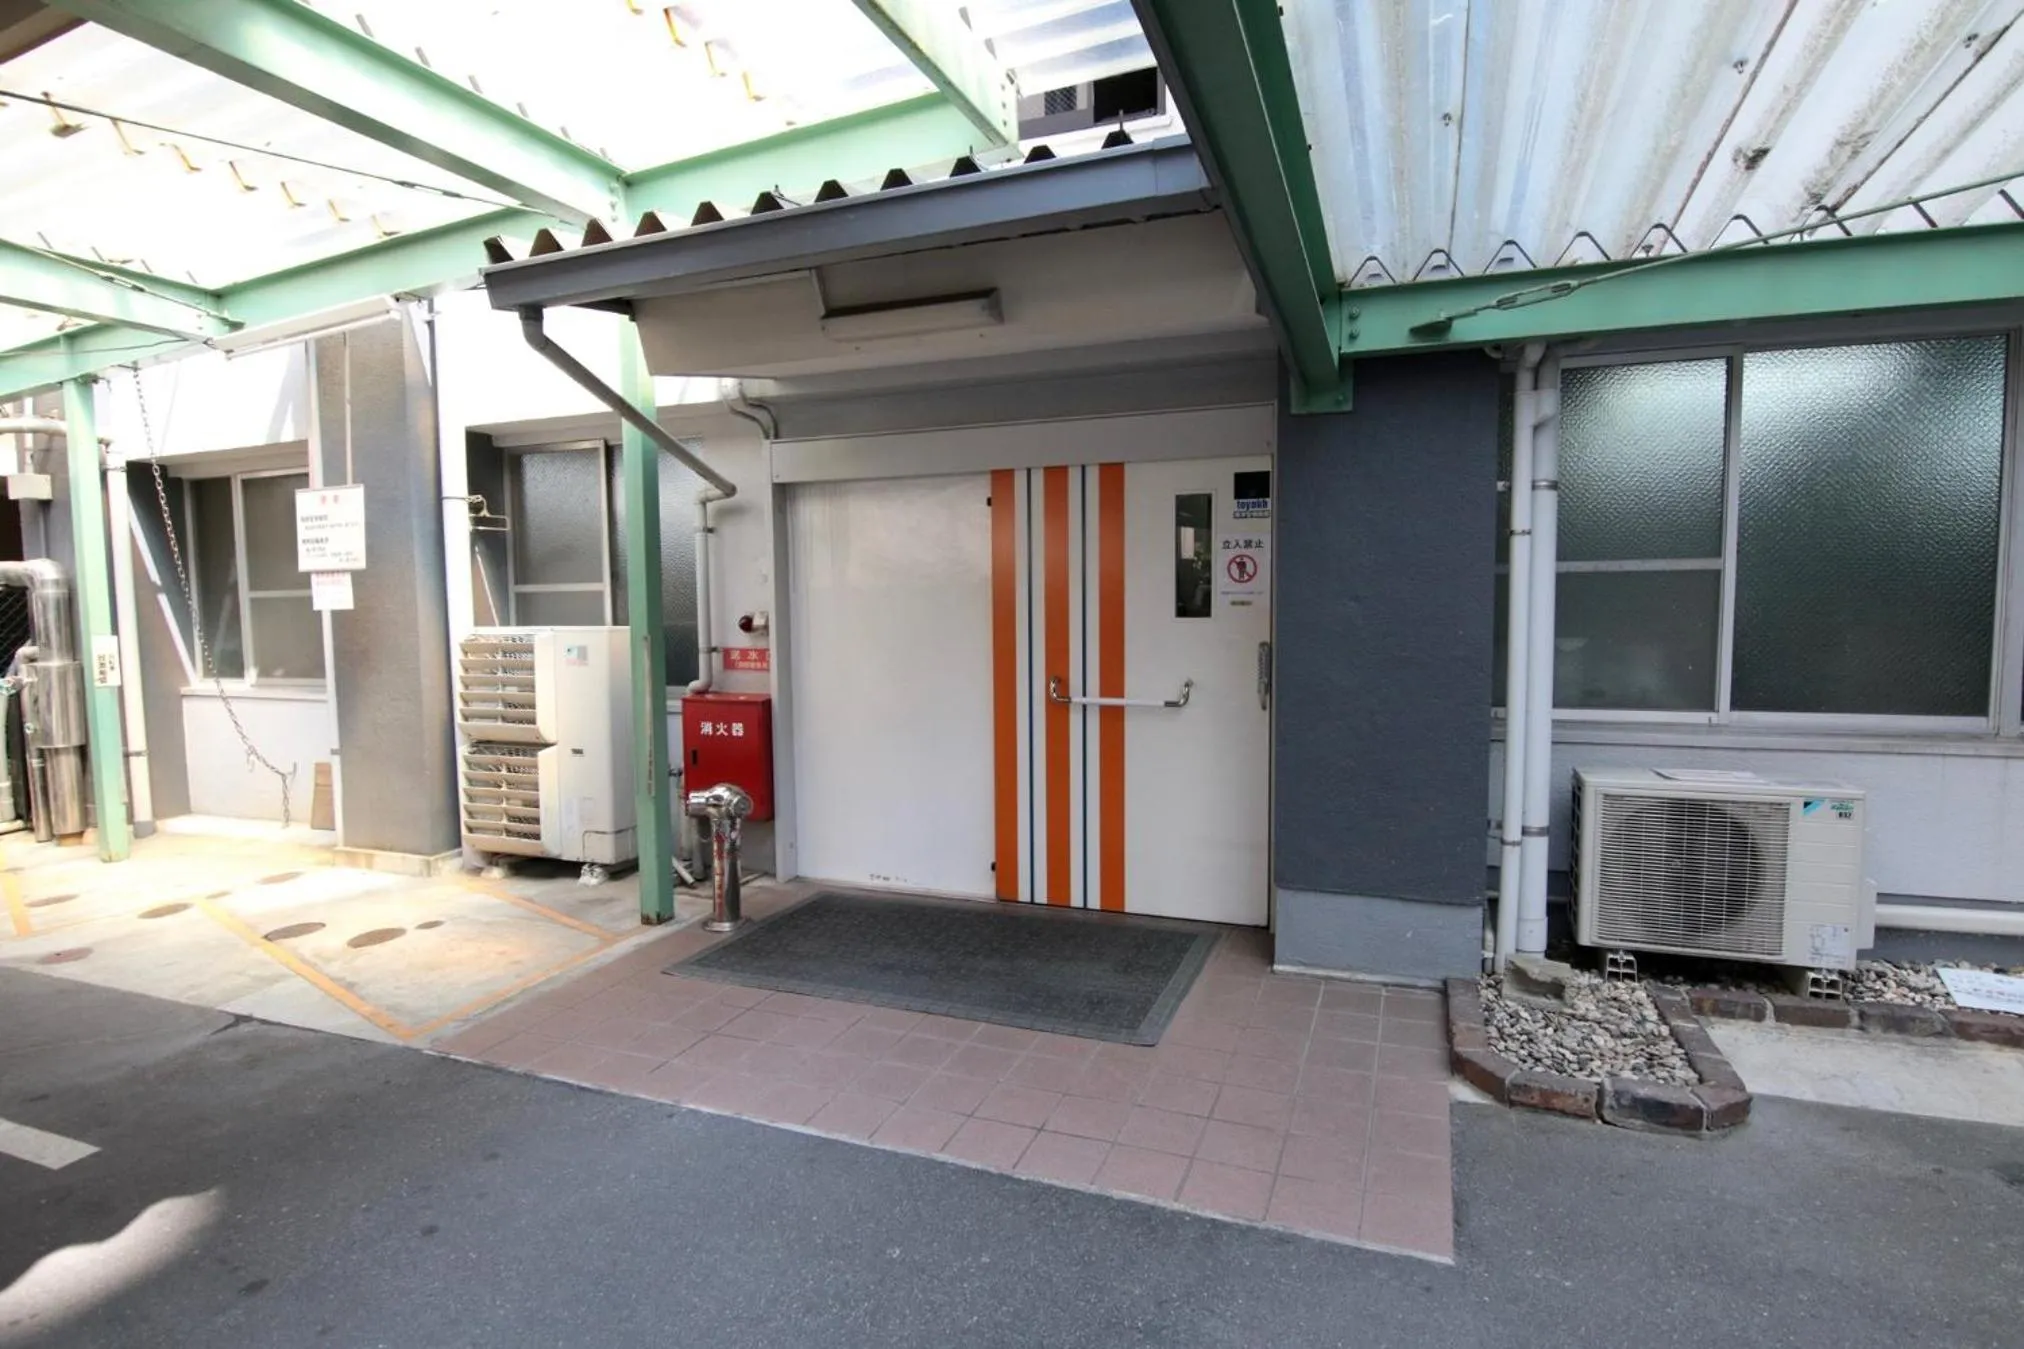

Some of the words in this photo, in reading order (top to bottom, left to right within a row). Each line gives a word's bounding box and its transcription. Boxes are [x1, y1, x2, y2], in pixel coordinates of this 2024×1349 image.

[1222, 539, 1264, 549] 立入禁止
[700, 721, 744, 737] 消火器
